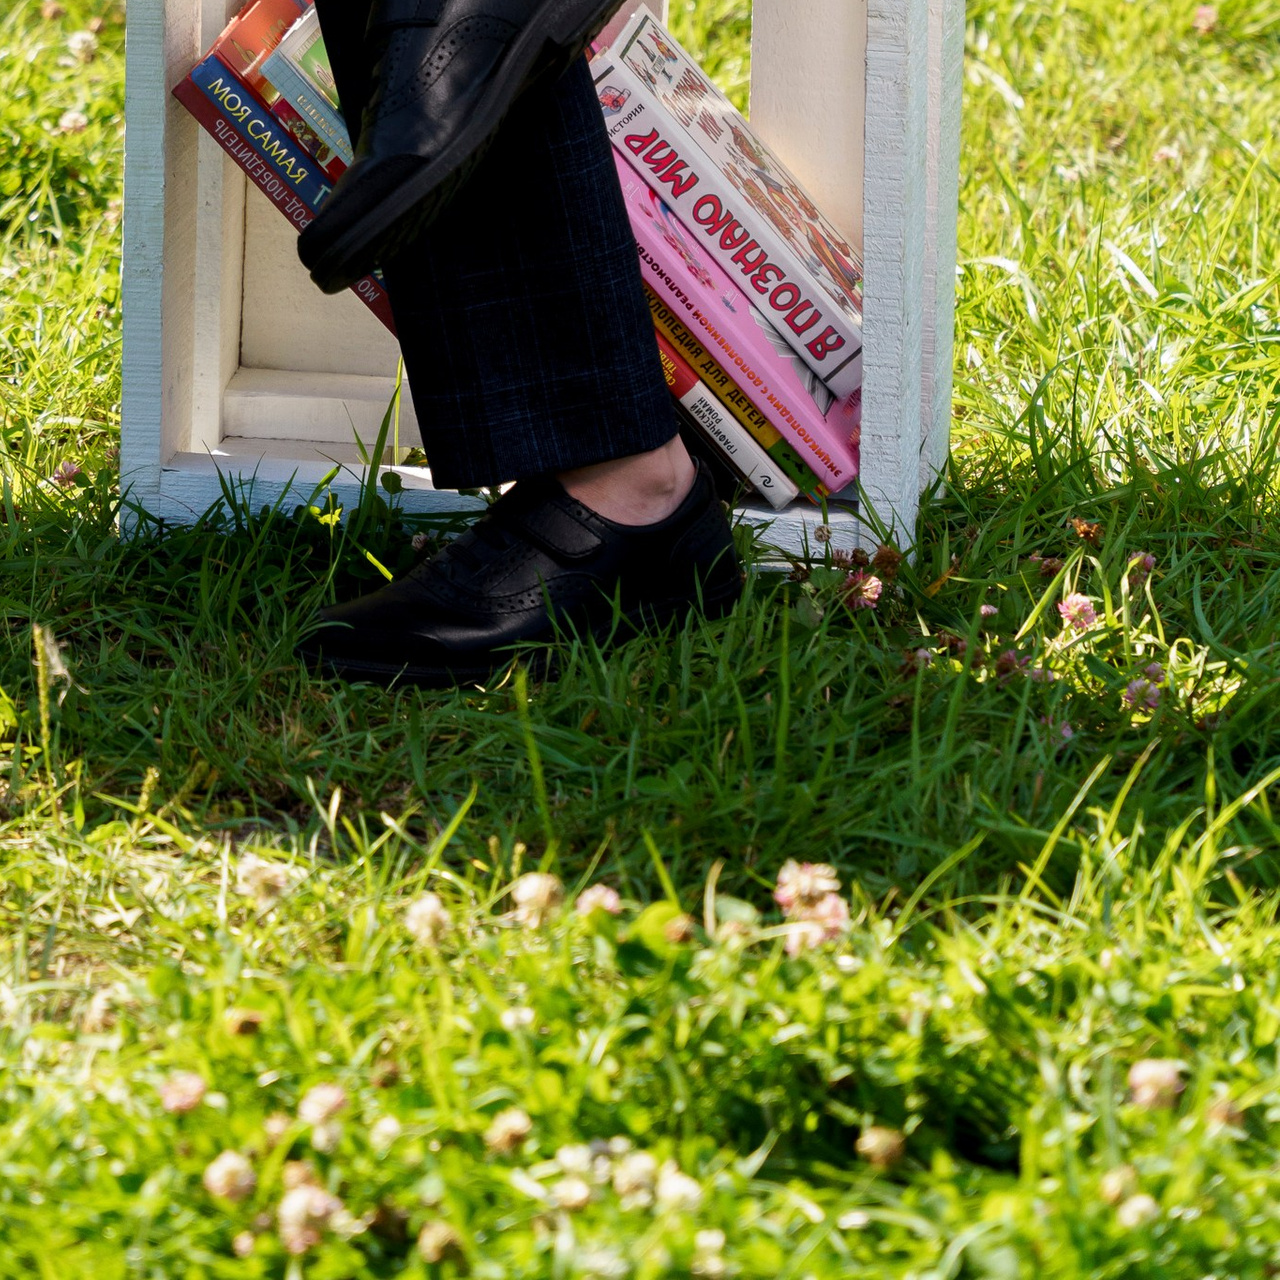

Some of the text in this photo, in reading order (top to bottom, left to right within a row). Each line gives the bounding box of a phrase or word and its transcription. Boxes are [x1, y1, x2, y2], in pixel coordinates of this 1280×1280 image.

[207, 77, 252, 122] МОЯ
[244, 115, 309, 185] САМАЯ
[608, 103, 645, 137] ИСТОРИЯ
[214, 118, 312, 227] РОД-ПОБЕДИТЕЛЬ
[621, 126, 847, 363] Я ПОЗНАЮ МИР
[635, 237, 695, 310] РЕАЛЬНОСТЬ
[689, 308, 763, 387] ДОПОЛНЕННОЙ
[688, 401, 738, 454] ГРАФИЧЕСКИЙ
[695, 395, 723, 424] РОМАН
[698, 357, 729, 389] ДЛЯ
[724, 387, 767, 430] ДЕТЕЙ
